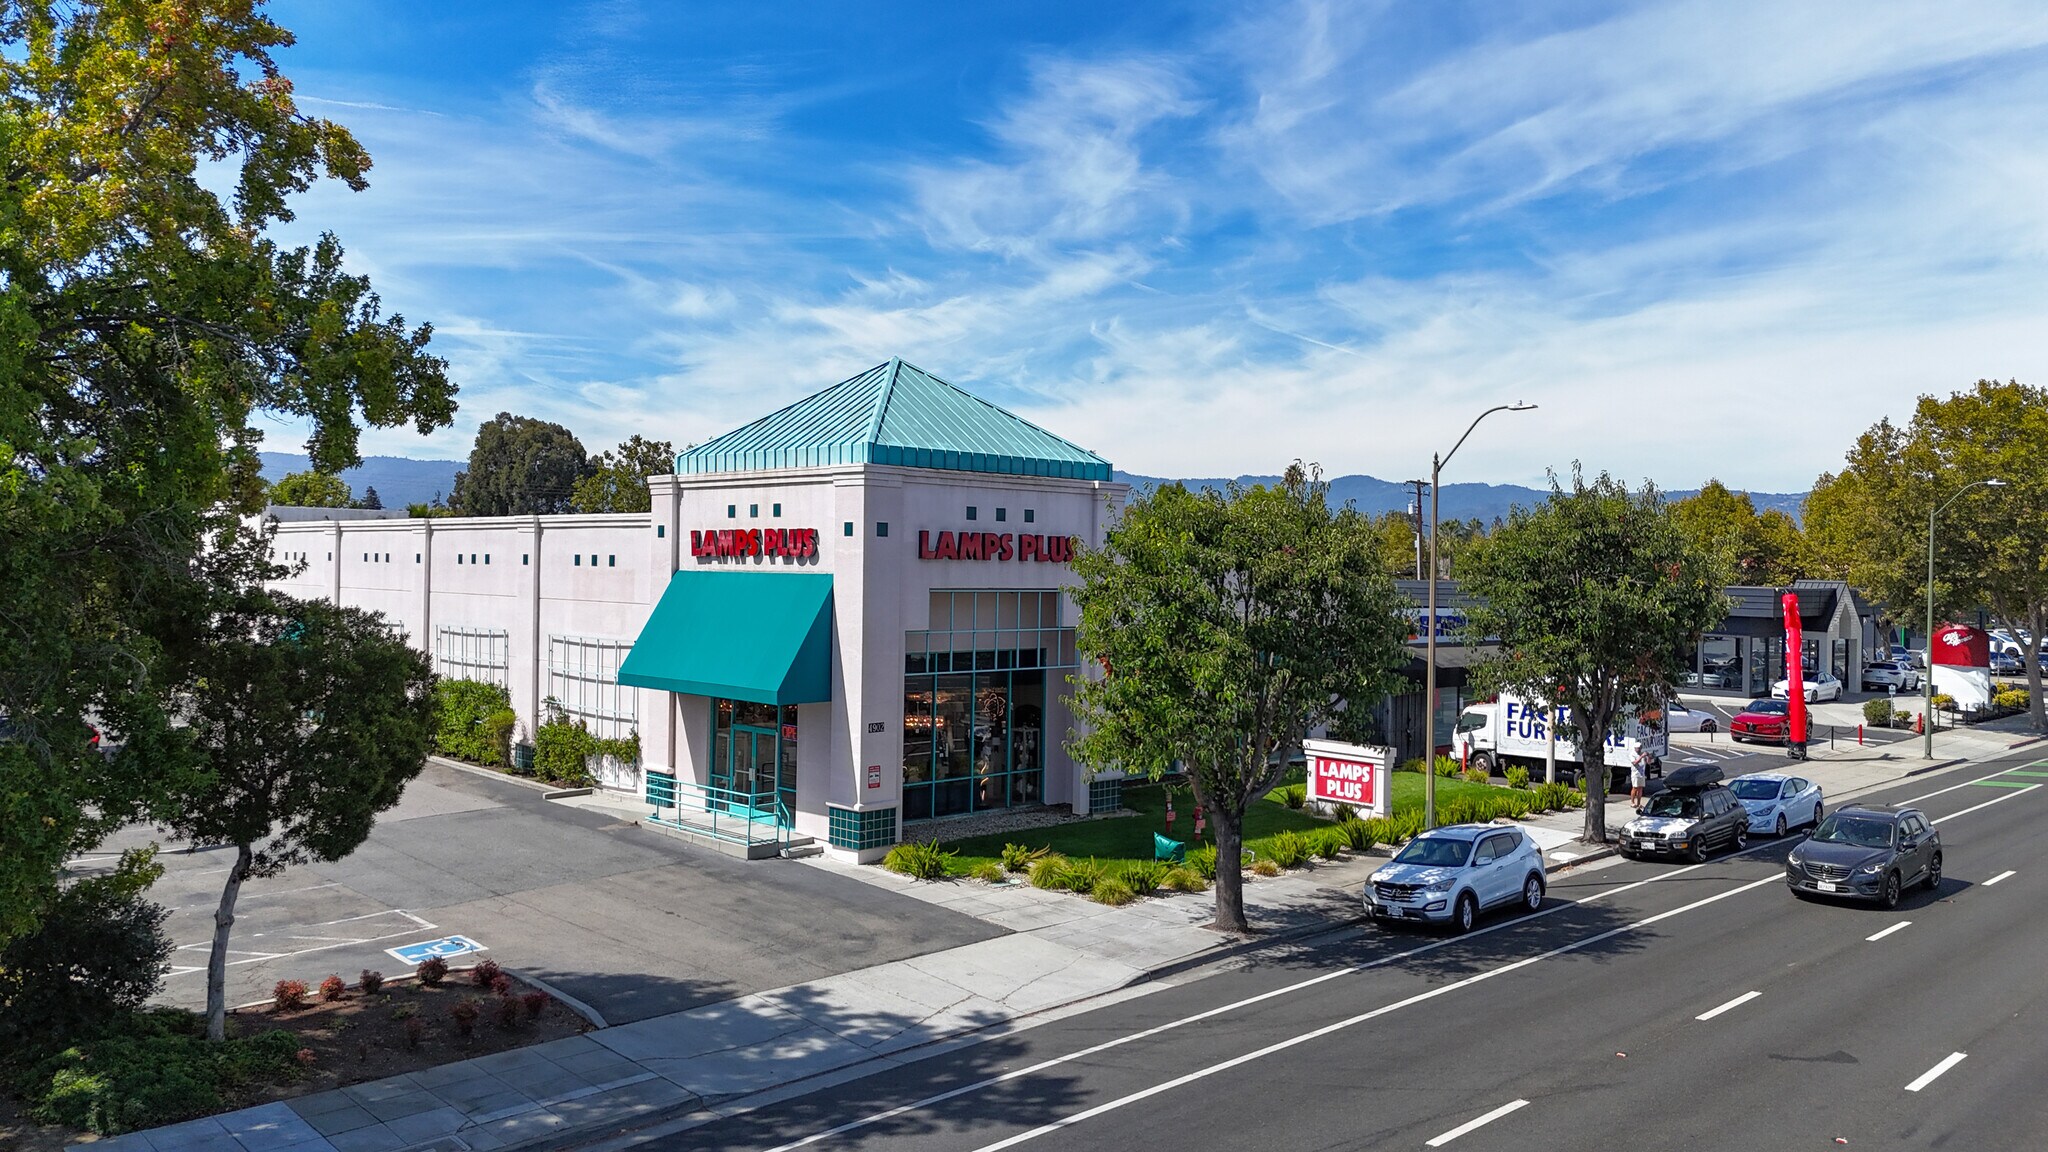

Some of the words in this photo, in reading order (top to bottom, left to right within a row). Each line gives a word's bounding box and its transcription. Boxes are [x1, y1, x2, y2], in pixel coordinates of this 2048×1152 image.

[690, 528, 760, 557] LAMPS
[763, 528, 815, 557] PLUS
[918, 530, 1013, 561] LAMPS
[1018, 533, 1076, 563] PLUS
[782, 725, 797, 740] OPE
[1507, 720, 1625, 748] FURRE
[1319, 760, 1370, 783] LAMPS
[1326, 779, 1362, 800] PLUS
